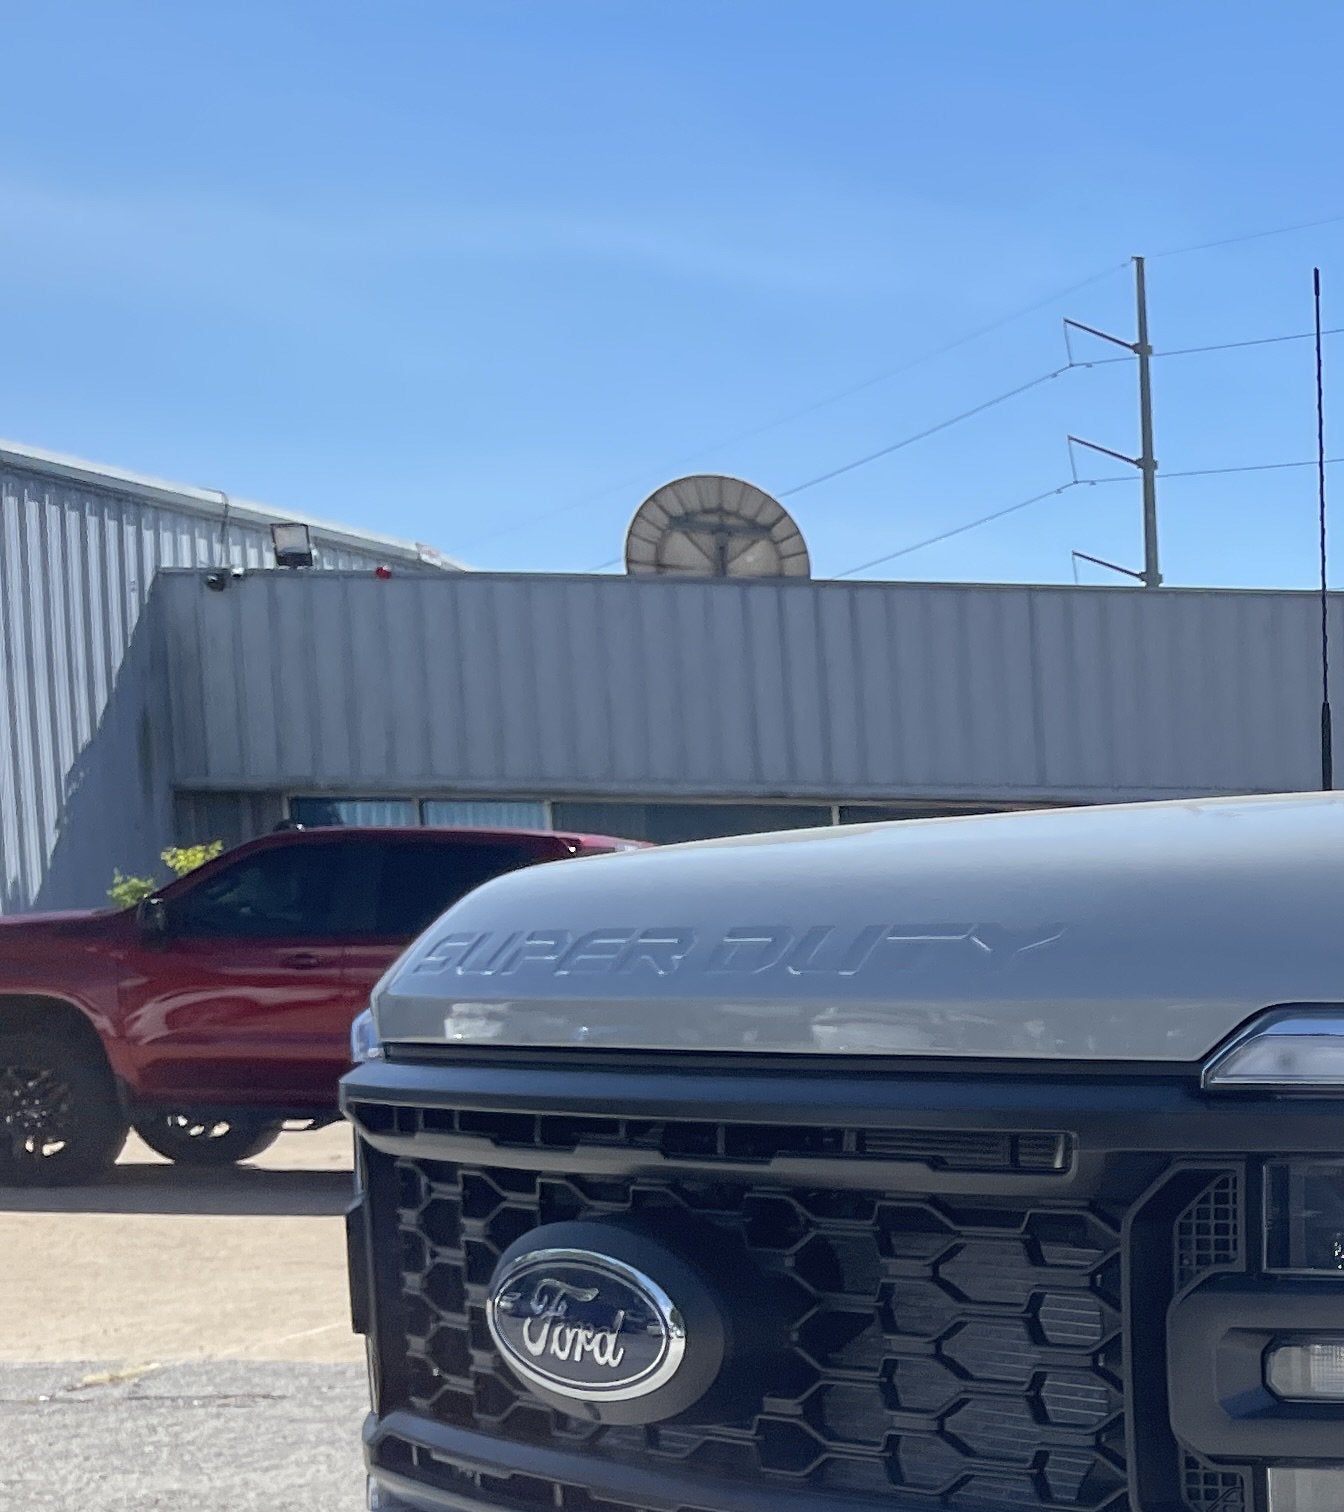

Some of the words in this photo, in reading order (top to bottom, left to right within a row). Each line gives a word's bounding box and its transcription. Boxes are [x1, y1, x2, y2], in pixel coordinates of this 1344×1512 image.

[411, 926, 699, 977] SUPER
[702, 923, 1066, 978] DUTY
[522, 1278, 626, 1368] Ford
